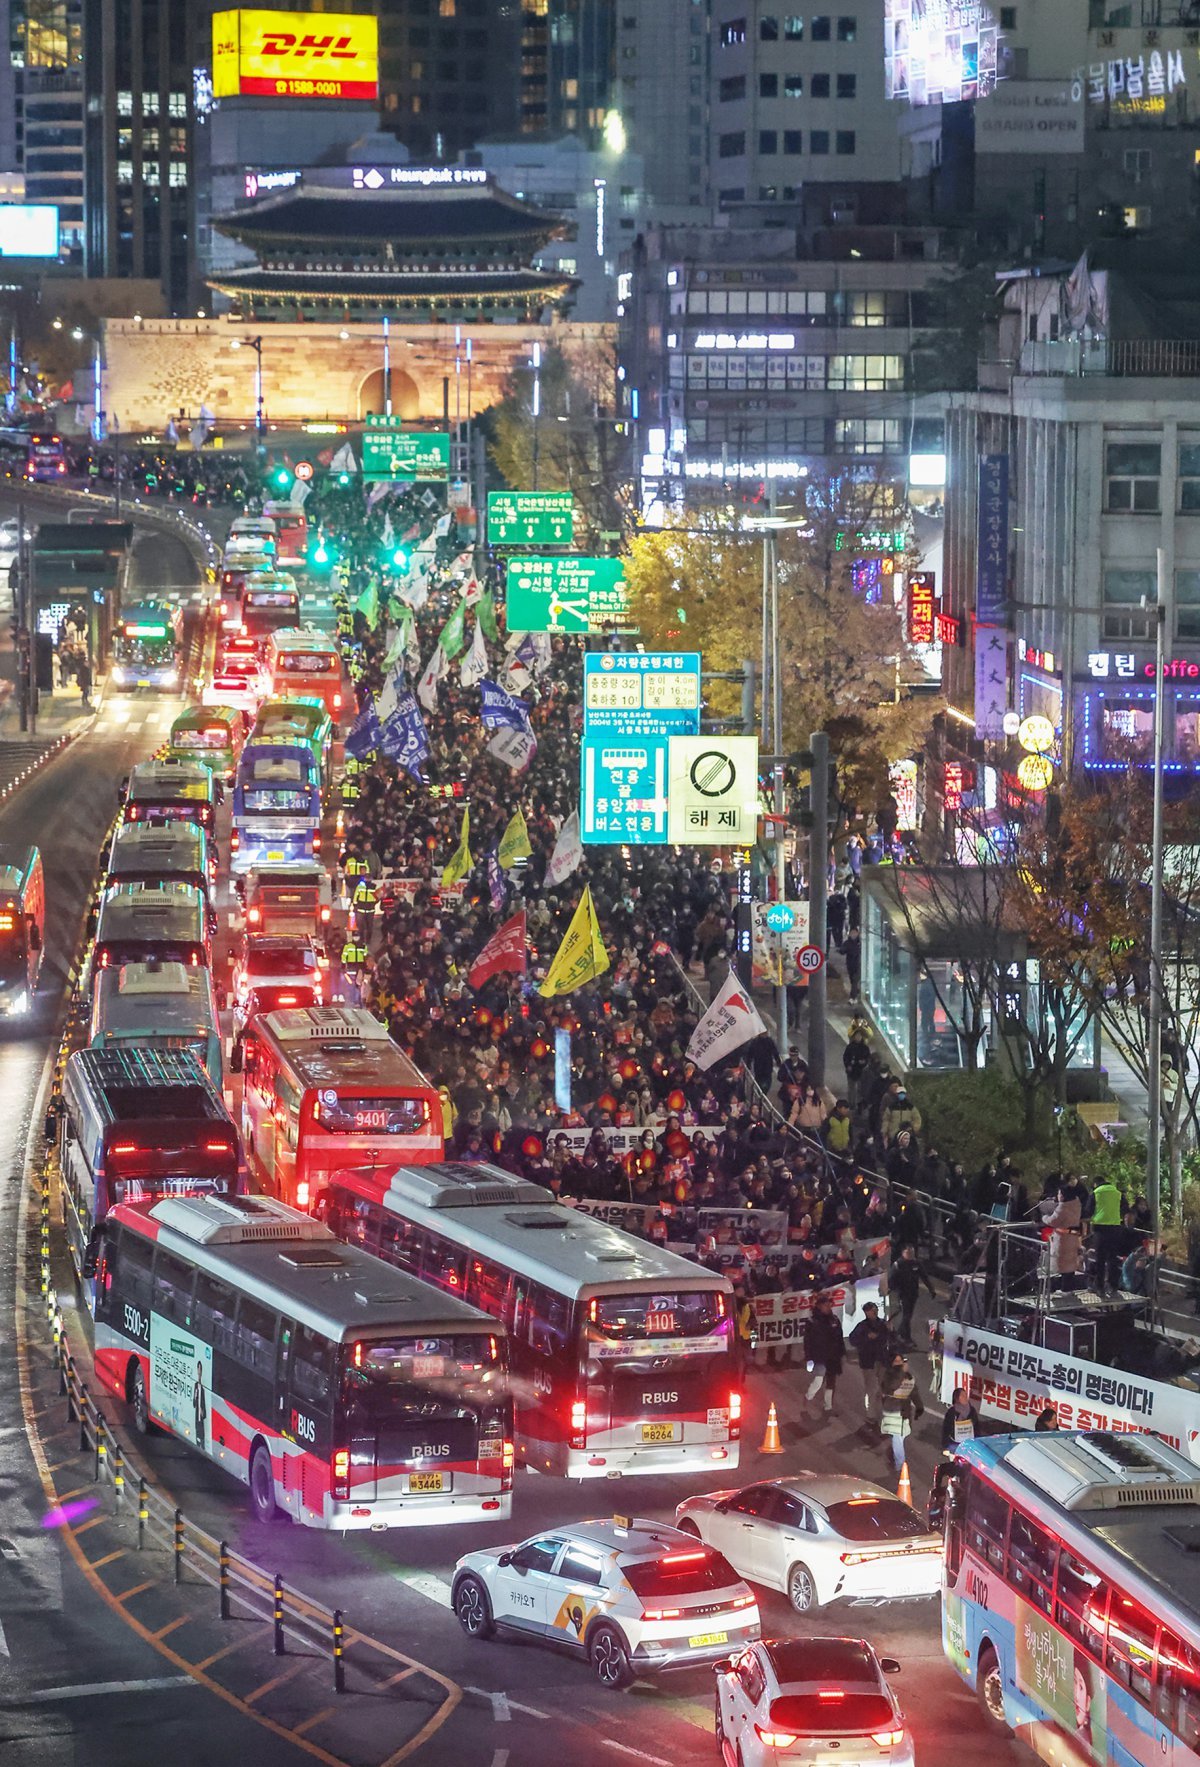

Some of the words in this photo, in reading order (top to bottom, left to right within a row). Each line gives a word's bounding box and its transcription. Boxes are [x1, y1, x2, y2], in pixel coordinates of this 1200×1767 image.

[261, 33, 358, 59] DHL
[1037, 119, 1077, 131] OPEN
[531, 577, 552, 587] 시청
[616, 656, 685, 669] 차량운행제한
[1088, 652, 1136, 677] 캡틴
[591, 677, 619, 689] 총중량
[648, 676, 666, 685] 높이
[647, 686, 666, 696] 길이
[610, 769, 640, 784] 전용
[595, 816, 653, 832] 버스전용
[802, 952, 819, 967] 50
[356, 1112, 386, 1127] 9401
[124, 1303, 149, 1342] 5500-2
[647, 1313, 675, 1331] 1101
[954, 1336, 1005, 1373] 120만
[1007, 1349, 1083, 1396] 민주노총의
[1086, 1371, 1154, 1417] 명령이다!
[649, 1430, 673, 1441] 8264
[417, 1480, 442, 1491] 3445
[965, 1568, 989, 1611] M4102
